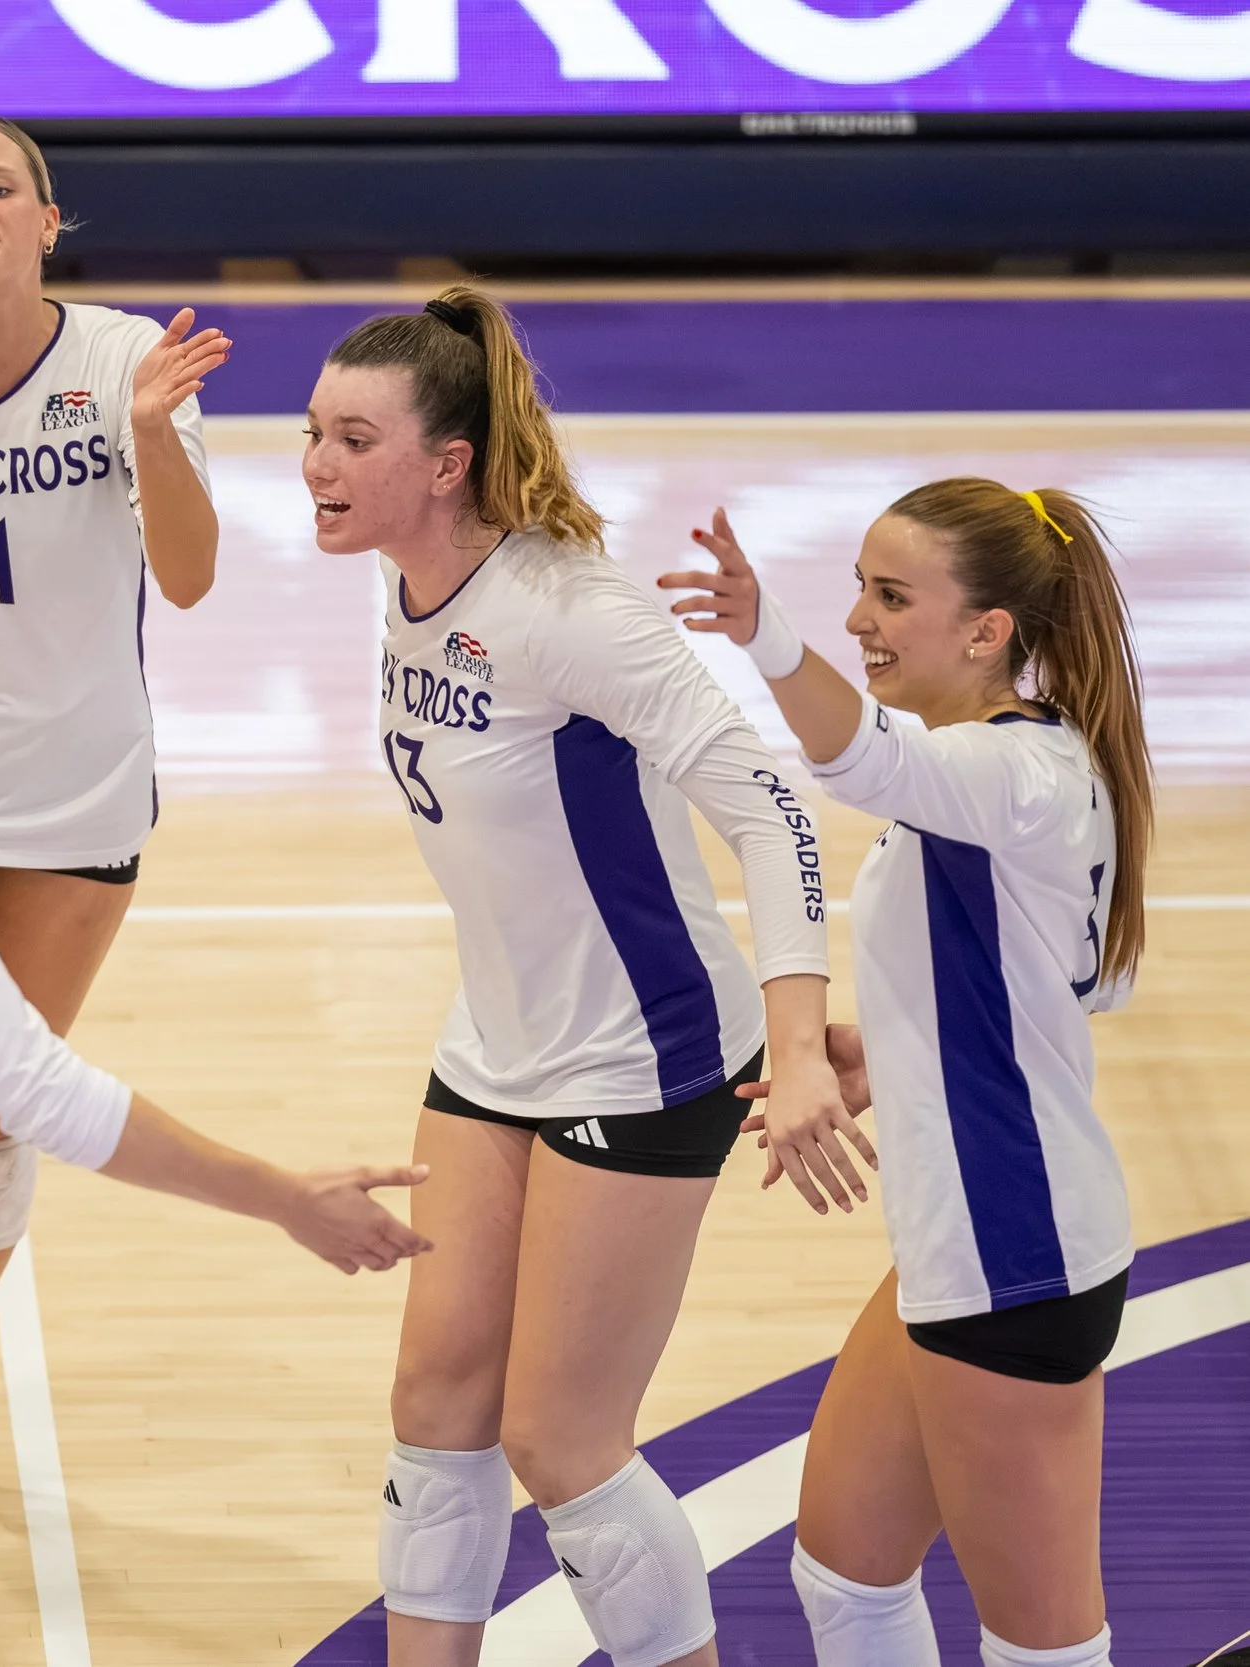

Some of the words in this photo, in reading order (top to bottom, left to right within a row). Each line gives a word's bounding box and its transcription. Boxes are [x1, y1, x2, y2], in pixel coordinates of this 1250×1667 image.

[41, 402, 99, 422] PATRIT
[42, 411, 100, 432] LEAGUE
[443, 648, 493, 673] PATRIOT
[446, 657, 494, 684] LEAGUE
[403, 667, 492, 732] CROSS
[384, 730, 443, 824] 13
[752, 769, 824, 923] CRUSADERS
